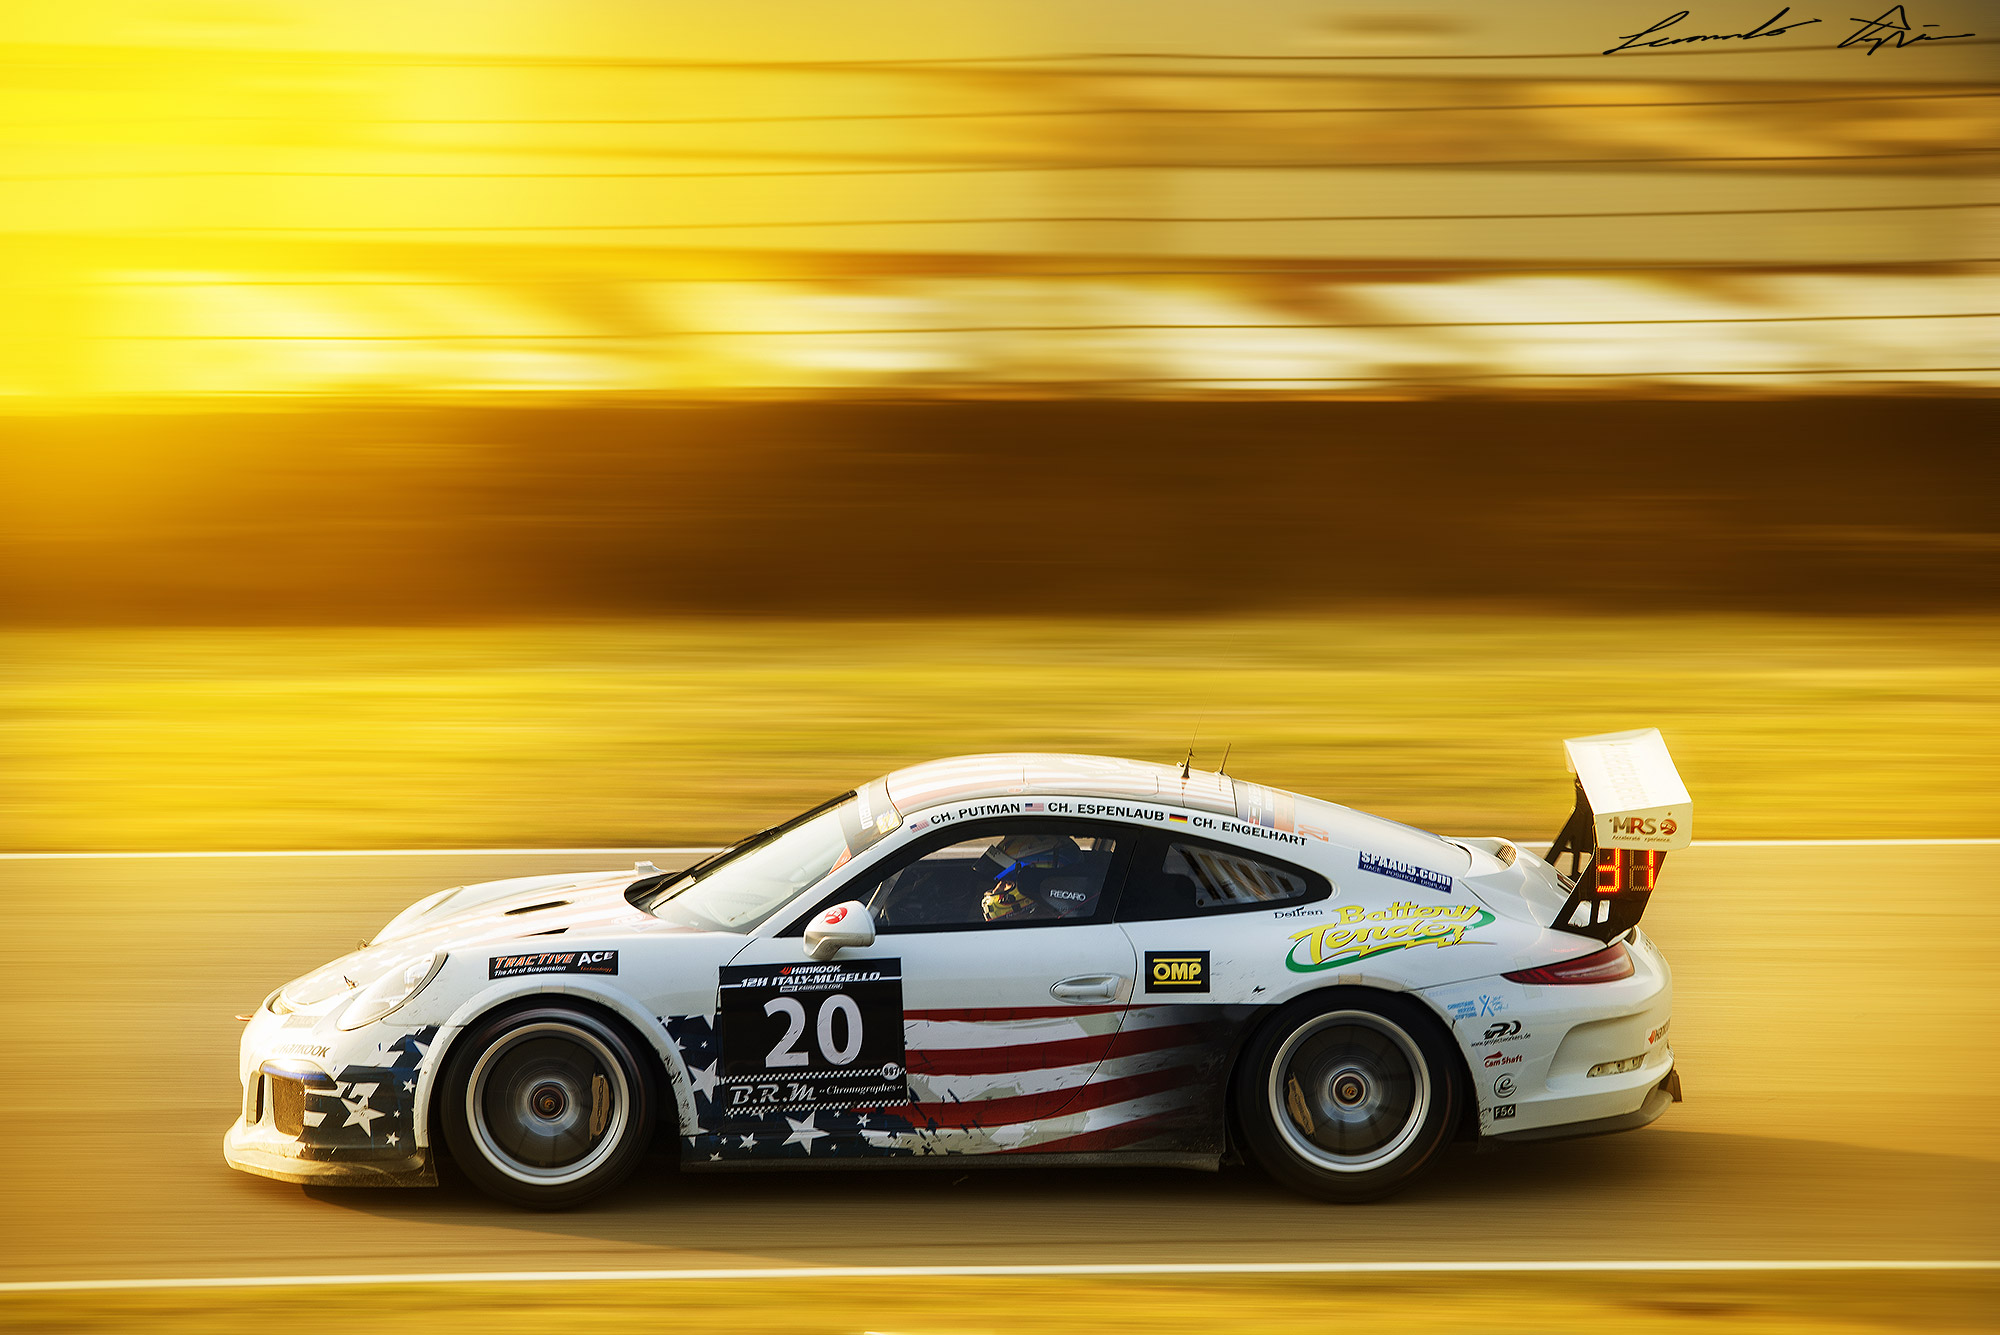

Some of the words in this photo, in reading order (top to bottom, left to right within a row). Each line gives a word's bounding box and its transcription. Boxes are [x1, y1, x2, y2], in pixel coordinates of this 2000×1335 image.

[930, 811, 956, 827] CH.
[958, 803, 1021, 819] PUTMAN
[1047, 802, 1074, 814] CH.
[1077, 803, 1165, 822] ESPENLAUB
[1192, 816, 1217, 831] CH.
[1221, 821, 1308, 847] ENGELHART
[1613, 816, 1657, 835] MRS
[1361, 850, 1451, 887] SPAA05.com
[1050, 889, 1086, 902] RECARO
[1332, 901, 1481, 926] Battery
[1288, 920, 1469, 965] Tender
[578, 951, 614, 967] ACE
[494, 969, 507, 977] The
[507, 967, 518, 976] Art
[518, 966, 526, 974] of
[526, 965, 567, 974] Suspension
[740, 977, 769, 988] 12H
[771, 972, 881, 987] ITALY-MUGELLO
[1153, 962, 1202, 981] OMP
[763, 993, 864, 1069] 20
[1484, 1059, 1501, 1069] Cam
[1501, 1054, 1523, 1066] Shaft
[729, 1082, 818, 1105] B.R.M
[1495, 1104, 1514, 1118] F56
